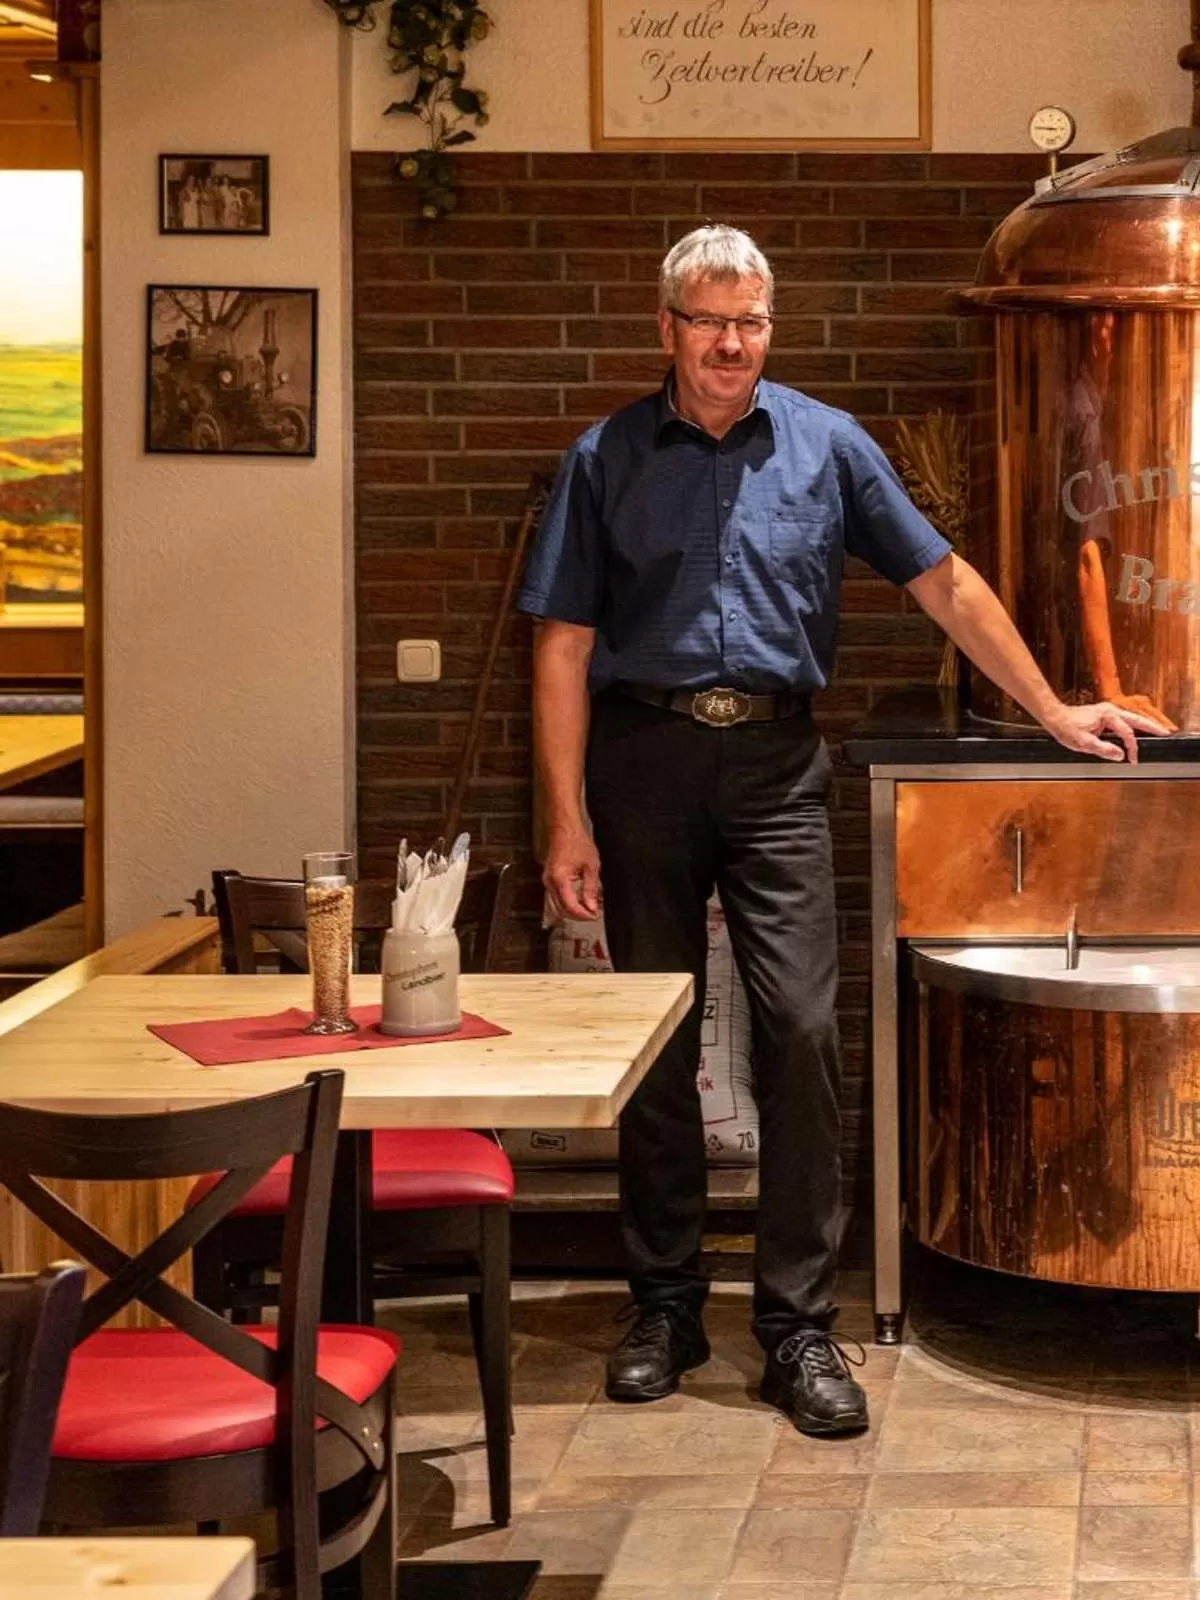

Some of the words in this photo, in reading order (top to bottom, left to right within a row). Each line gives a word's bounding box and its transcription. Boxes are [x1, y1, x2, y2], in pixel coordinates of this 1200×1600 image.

[618, 9, 679, 39] sind
[683, 11, 725, 39] die
[738, 11, 818, 39] besten
[637, 48, 874, 105] Zeitvertreiber!
